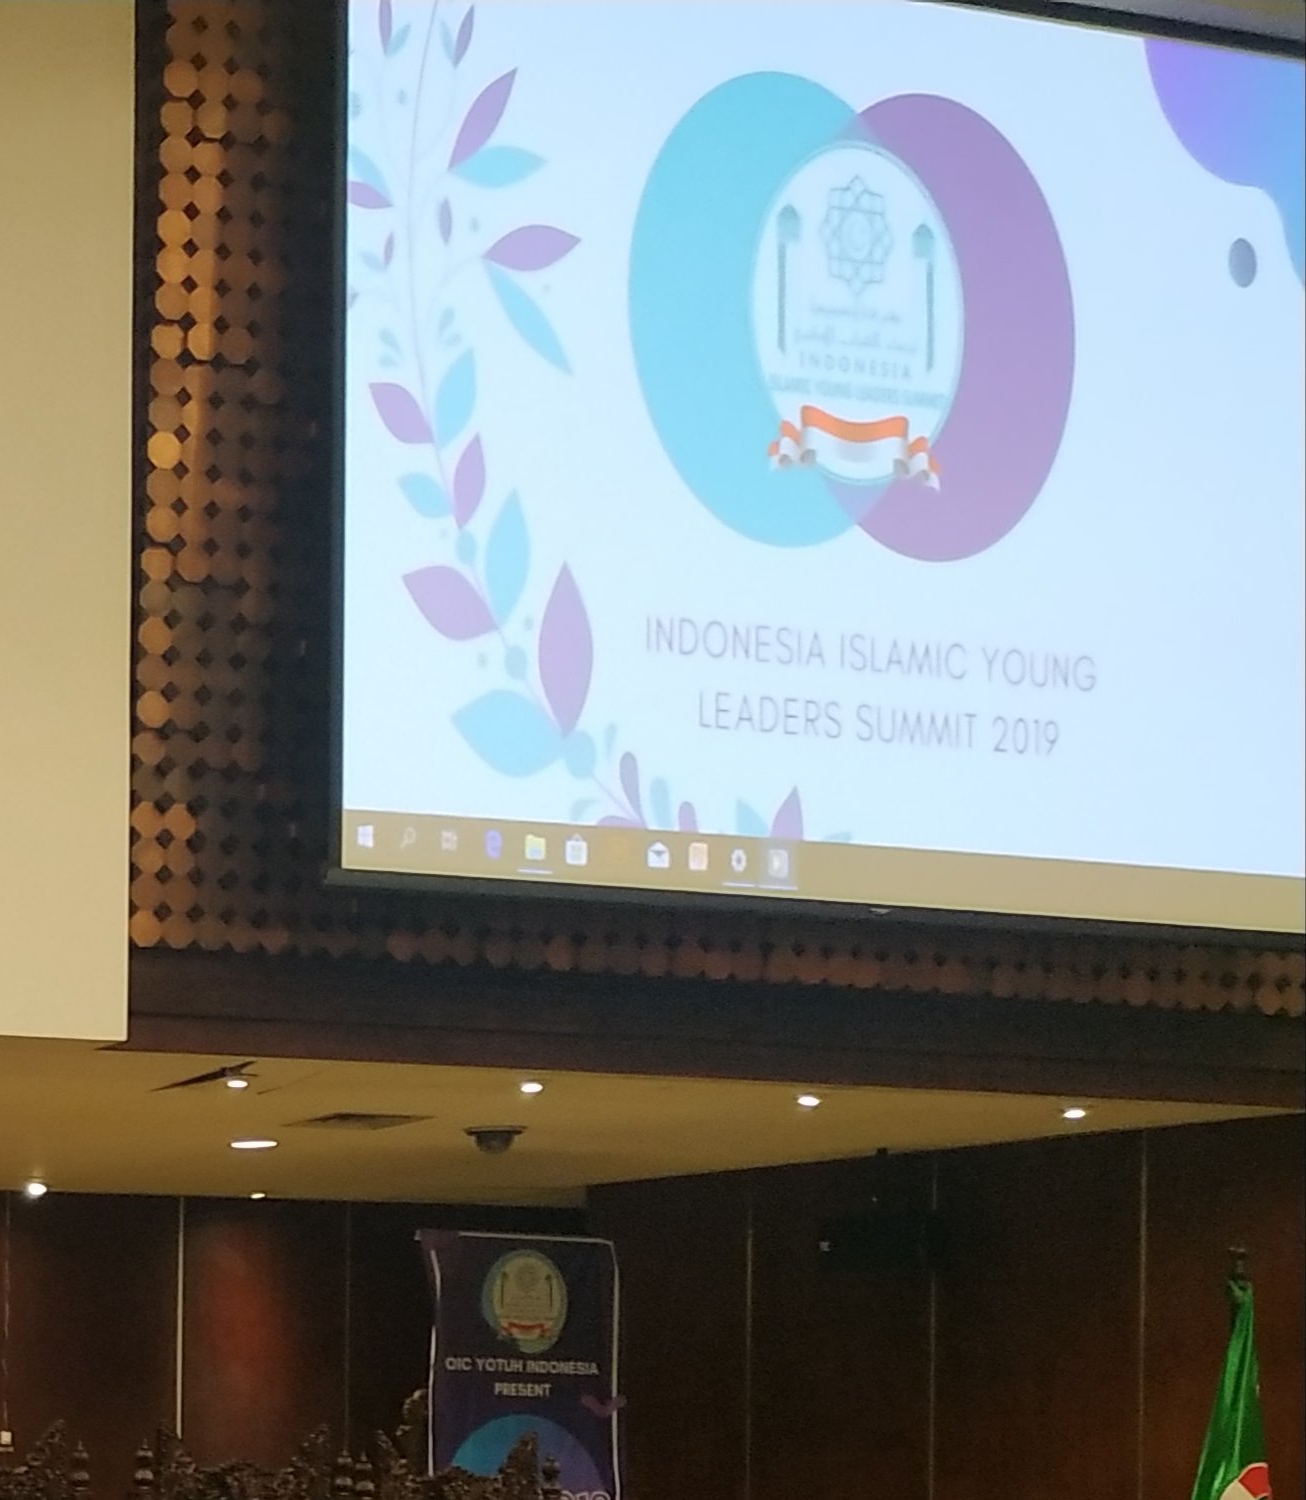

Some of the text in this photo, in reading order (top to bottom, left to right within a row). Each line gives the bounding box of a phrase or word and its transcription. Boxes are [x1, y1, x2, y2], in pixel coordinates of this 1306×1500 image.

[645, 615, 1097, 692] INDONESIA ISLAMIC YOUNG
[698, 690, 1059, 756] LEADERS SUMMIT 2019
[445, 1357, 472, 1371] OIC
[526, 1360, 599, 1375] INDONESIA
[494, 1382, 552, 1397] PRESENT
